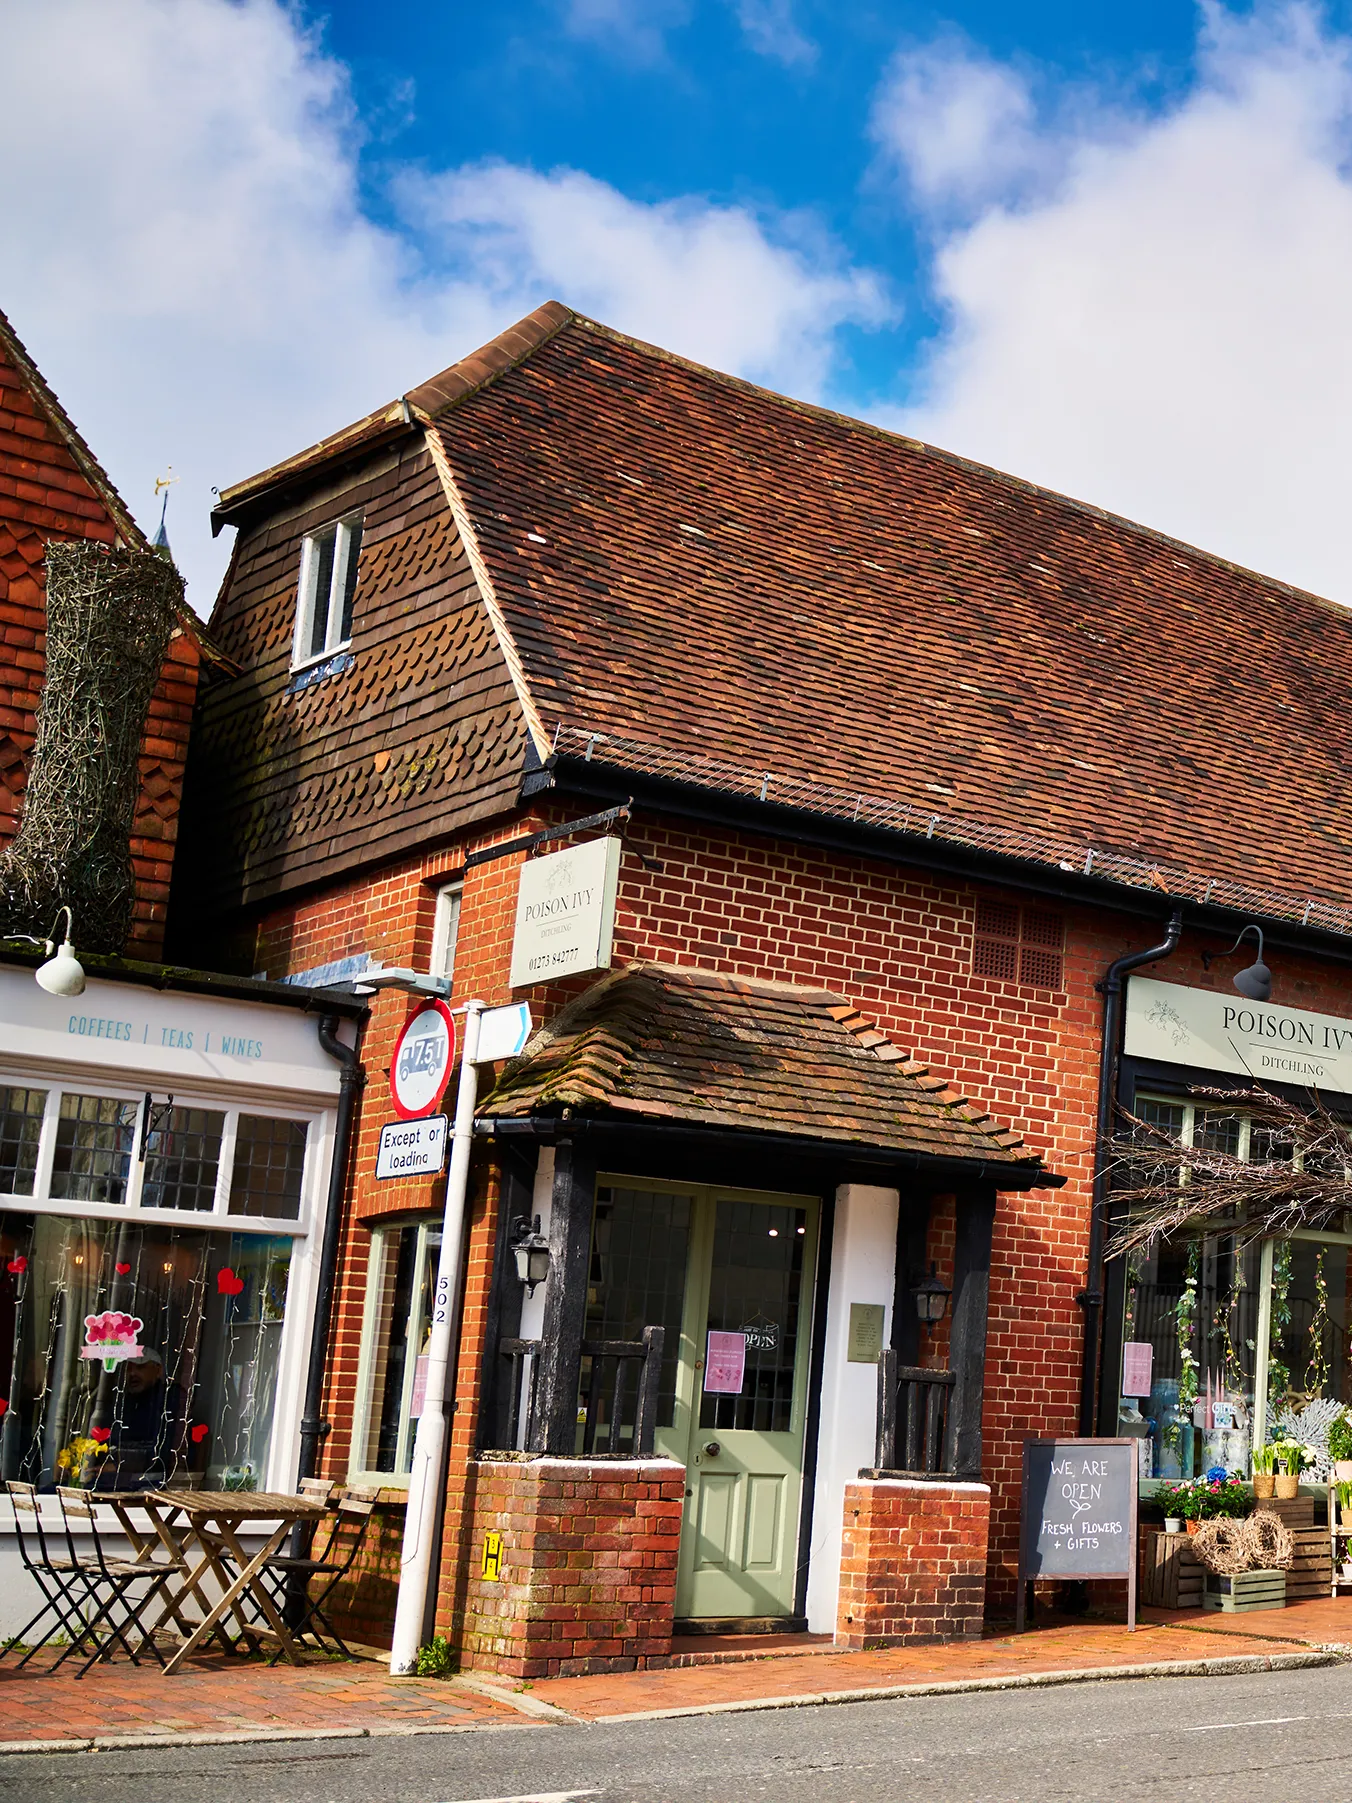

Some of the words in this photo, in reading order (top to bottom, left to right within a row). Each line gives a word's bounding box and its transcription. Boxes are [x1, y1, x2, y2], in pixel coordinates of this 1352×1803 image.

[525, 895, 569, 922] POISON
[572, 887, 594, 909] IVY
[528, 955, 550, 971] 01273
[552, 947, 579, 965] 842777
[68, 1015, 132, 1041] COFFEES
[161, 1027, 194, 1049] TEAS
[221, 1035, 263, 1058] WINES
[1222, 1006, 1315, 1046] POISON
[1261, 1055, 1325, 1077] DITCHLING
[384, 1128, 421, 1148] Except
[1051, 1459, 1073, 1475] WE
[1081, 1460, 1109, 1476] ARE
[1061, 1483, 1102, 1500] OPEN
[1041, 1520, 1074, 1535] FRESH
[1081, 1521, 1123, 1535] FLOWERS
[1067, 1537, 1100, 1550] GIFTS
